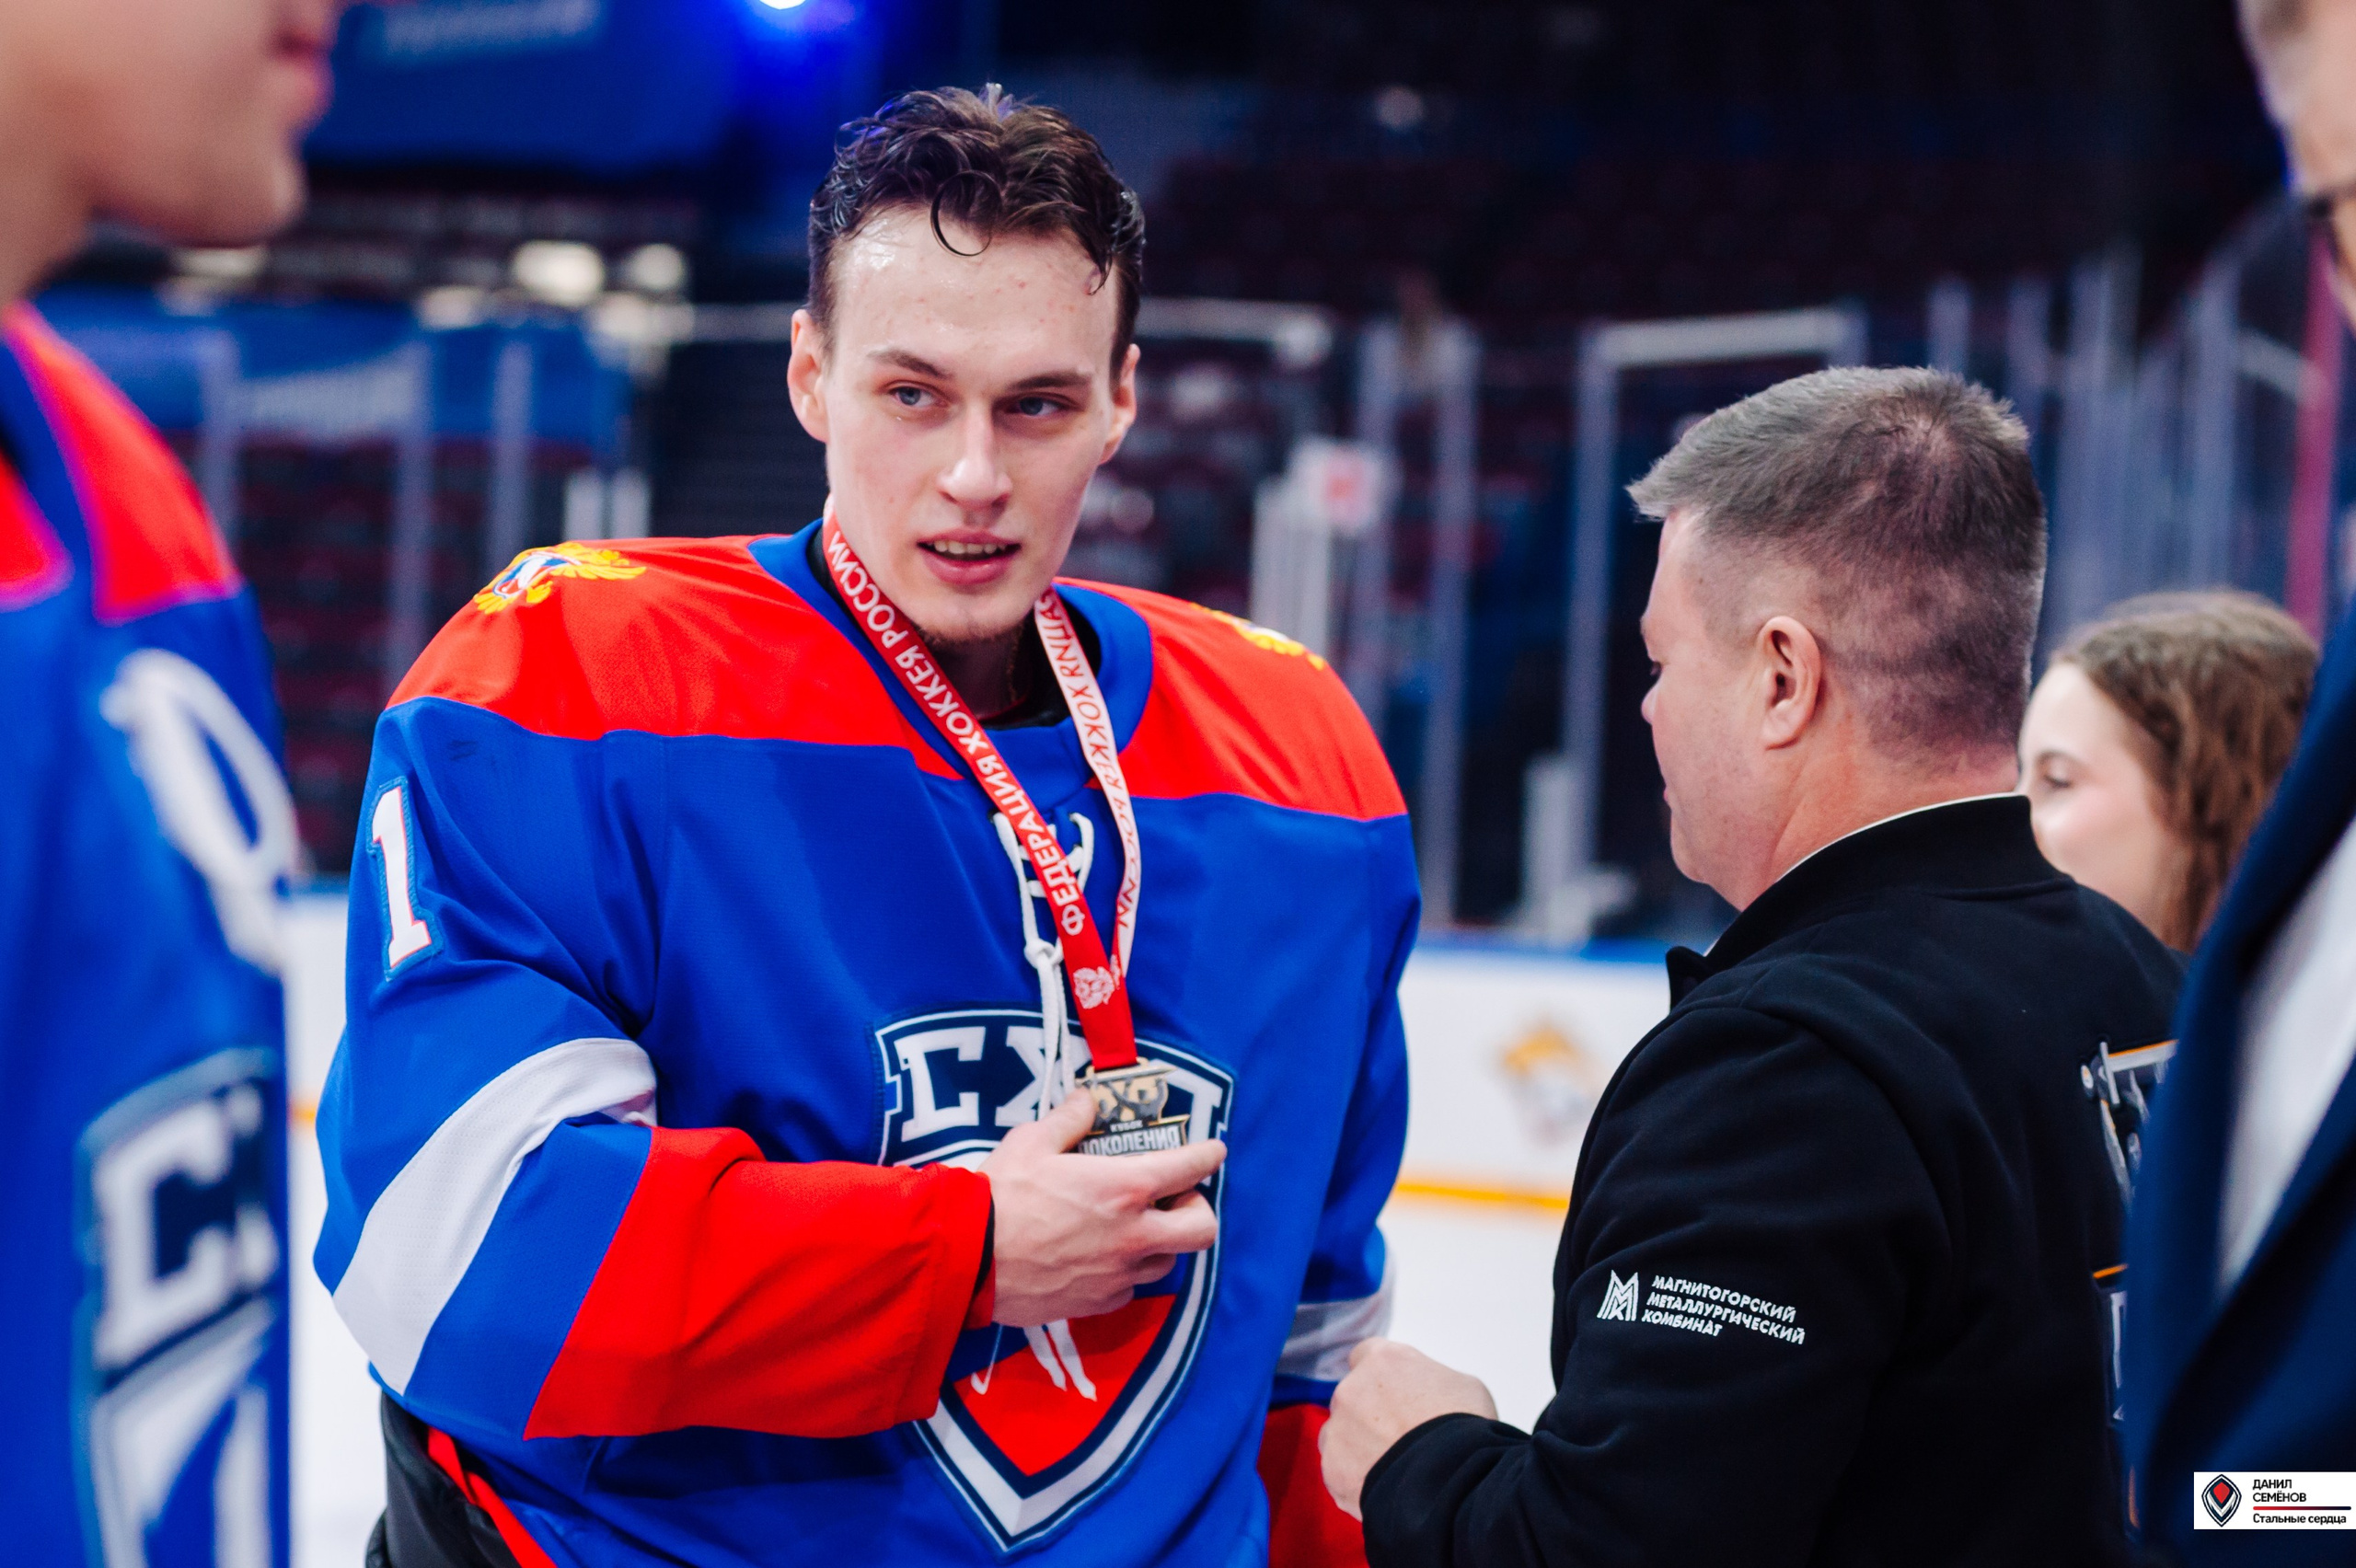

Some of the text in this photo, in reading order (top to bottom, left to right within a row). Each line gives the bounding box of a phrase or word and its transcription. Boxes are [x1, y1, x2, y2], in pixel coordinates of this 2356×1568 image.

[827, 530, 1086, 936] ФЕДЕРАЦИЯ ХОККЕЯ РОССИИ
[371, 784, 434, 972] 1
[1641, 1309, 1723, 1337] КОМБИНАТ
[1646, 1292, 1806, 1345] МЕТАЛЛУРГИЧЕСКИЙ
[1651, 1274, 1796, 1323] МАГНИТОГОРСКИЙ
